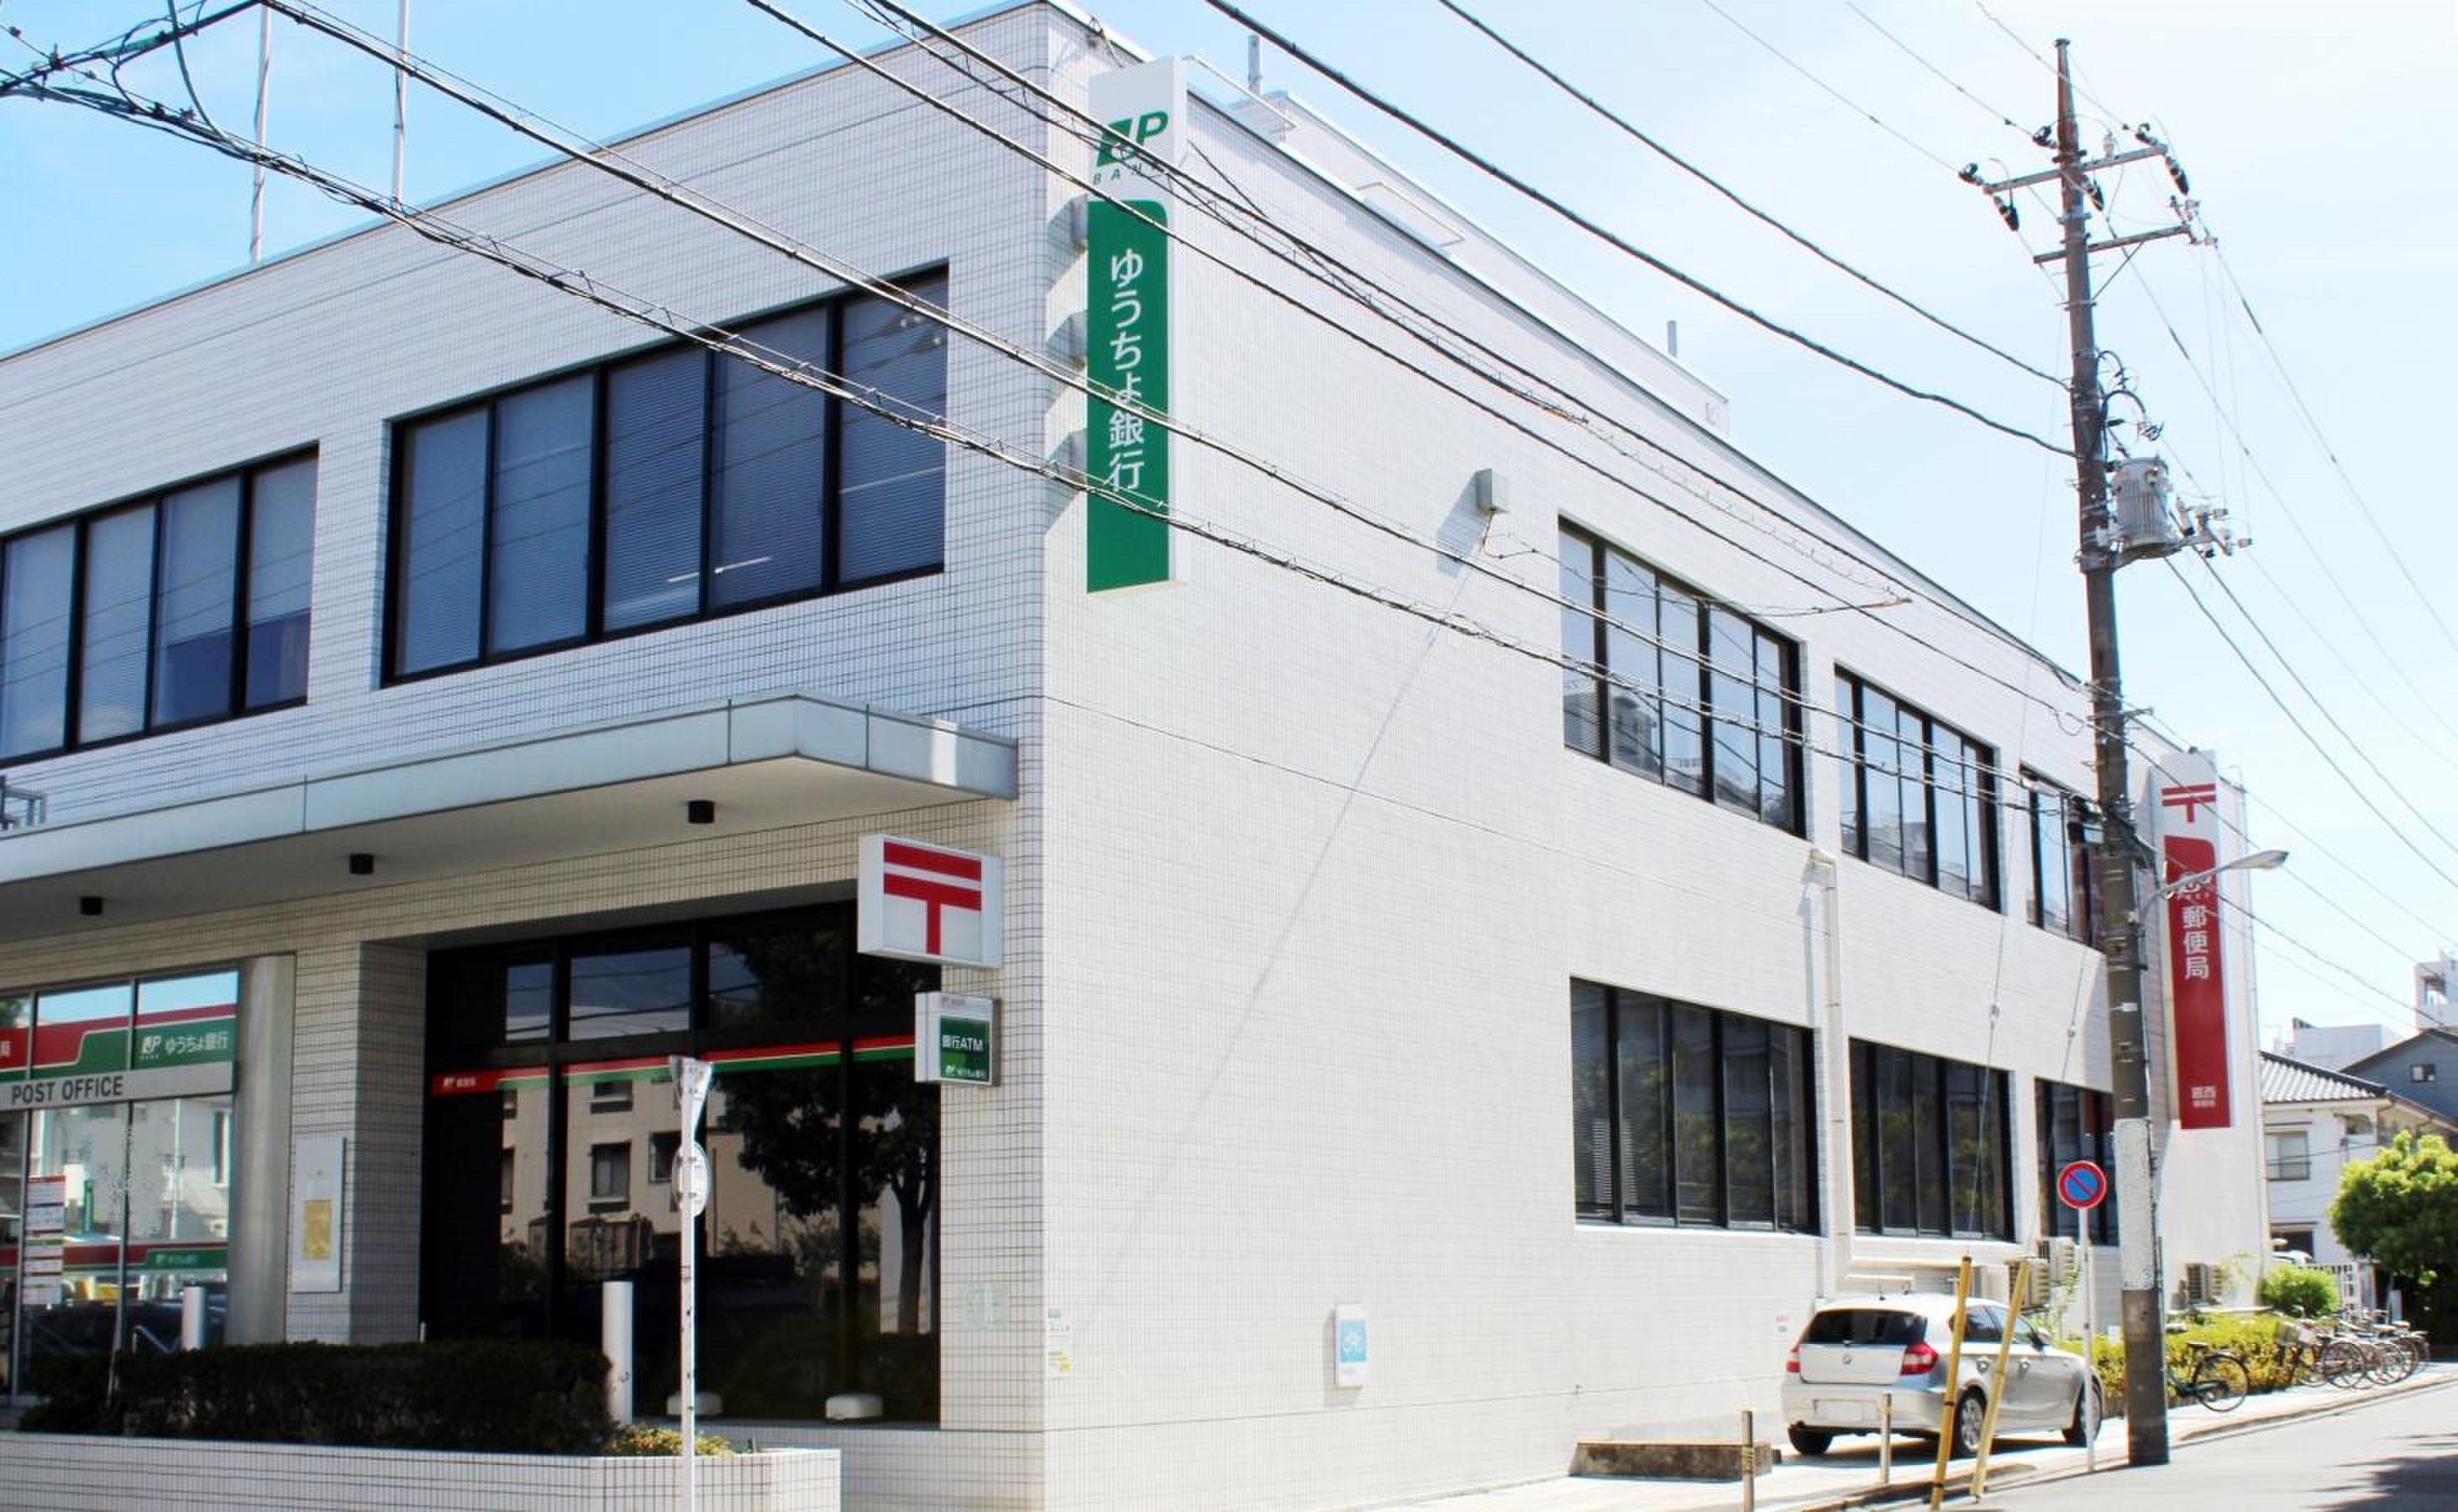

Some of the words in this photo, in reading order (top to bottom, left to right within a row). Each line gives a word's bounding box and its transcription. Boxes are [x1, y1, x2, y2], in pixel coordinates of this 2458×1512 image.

[1109, 248, 1144, 492] ゆうちょ銀行
[2182, 905, 2209, 980] 郵便局
[165, 1031, 229, 1055] ゆうちょ銀行
[12, 1081, 55, 1105] POST
[61, 1075, 123, 1100] OFFICE
